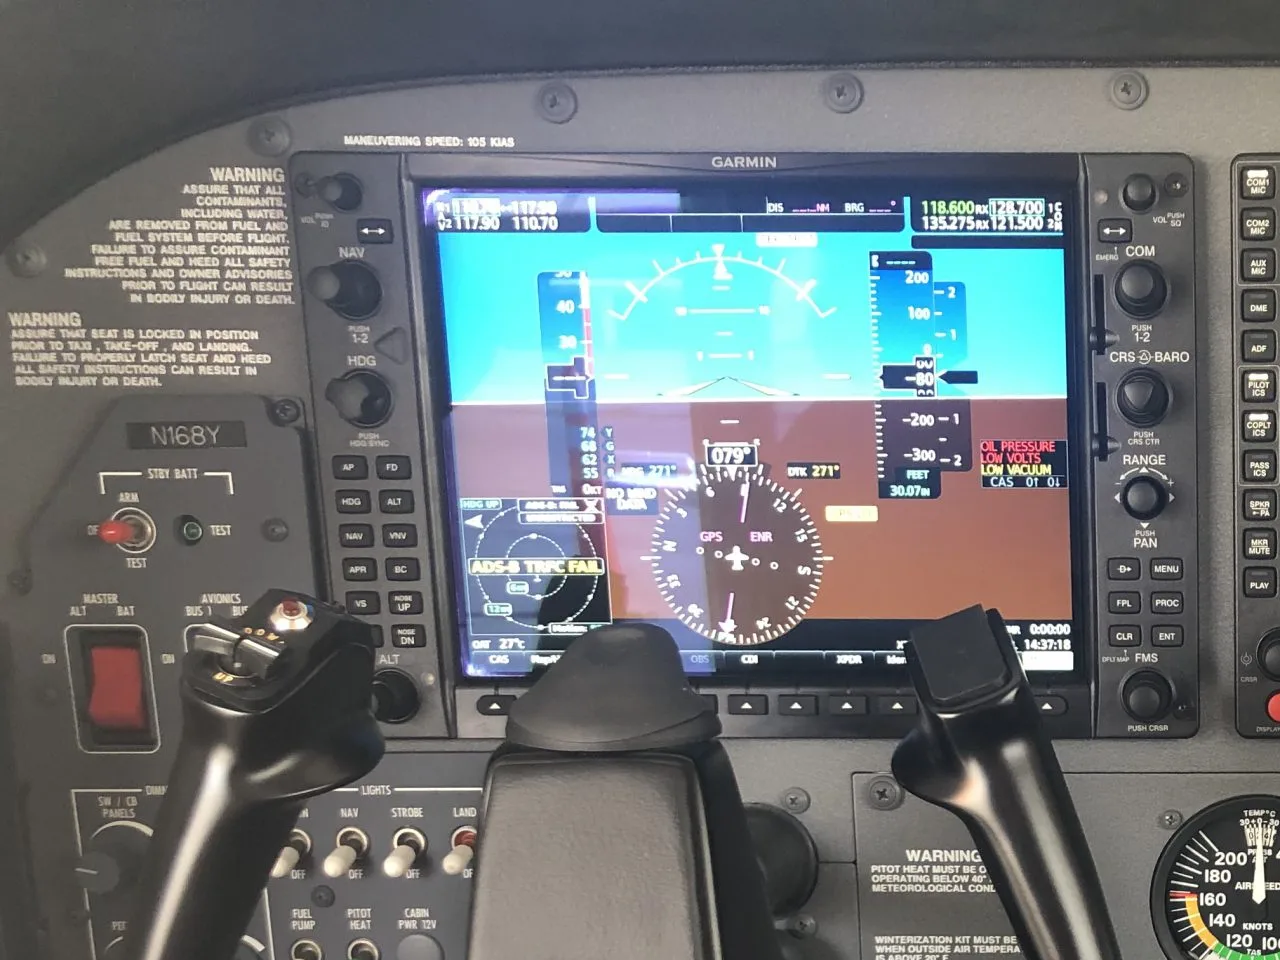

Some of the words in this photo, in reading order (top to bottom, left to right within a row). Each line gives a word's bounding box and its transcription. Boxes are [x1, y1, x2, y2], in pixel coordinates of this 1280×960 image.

[344, 136, 421, 146] MANEUVERING
[425, 137, 463, 146] SPEED:
[468, 137, 486, 147] 105
[491, 138, 514, 147] KIAS
[712, 156, 776, 168] GARMIN
[210, 167, 284, 182] WARNING
[1247, 178, 1269, 186] COM1
[233, 185, 261, 195] THAT
[266, 186, 285, 195] ALL
[922, 201, 975, 214] 118.600
[991, 202, 1043, 215] 128.700
[922, 216, 975, 230] 135.275
[991, 217, 1043, 230] 121.500
[1126, 246, 1155, 257] COM
[906, 272, 929, 284] 200
[908, 308, 930, 319] 100
[1110, 352, 1135, 362] CRS
[1155, 352, 1189, 362] BARO
[151, 426, 219, 445] N168Y
[981, 441, 997, 452] OIL
[1001, 439, 1055, 452] PRESSURE
[981, 453, 1003, 463] LOW
[1007, 453, 1041, 463] VOLTS
[1123, 455, 1165, 465] RANGE
[148, 468, 169, 479] STBY
[175, 468, 197, 479] BATT
[981, 465, 1002, 475] LOW
[1005, 464, 1051, 476] VACUUM
[990, 477, 1014, 487] CAS
[210, 525, 231, 535] TEST
[699, 531, 723, 542] GPS
[750, 532, 772, 542] ENR
[1134, 538, 1157, 548] PAN
[1155, 565, 1178, 573] MENU
[1156, 599, 1179, 607] PROC
[1030, 624, 1070, 634] 0:00:00
[1024, 639, 1071, 650] 14:37:18
[1135, 653, 1158, 662] FMS
[362, 785, 391, 795] LIGHTS
[341, 808, 358, 817] NAV
[392, 808, 423, 817] STROBE
[906, 850, 982, 862] WARNING
[1215, 851, 1247, 866] 200
[1205, 869, 1231, 883] 180
[1200, 893, 1226, 906] 160
[292, 909, 312, 918] FUEL
[348, 908, 371, 918] PITOT
[292, 920, 315, 930] PUMP
[350, 920, 371, 929] HEAT
[1209, 913, 1235, 927] 140
[875, 936, 952, 944] WINTERIZATION
